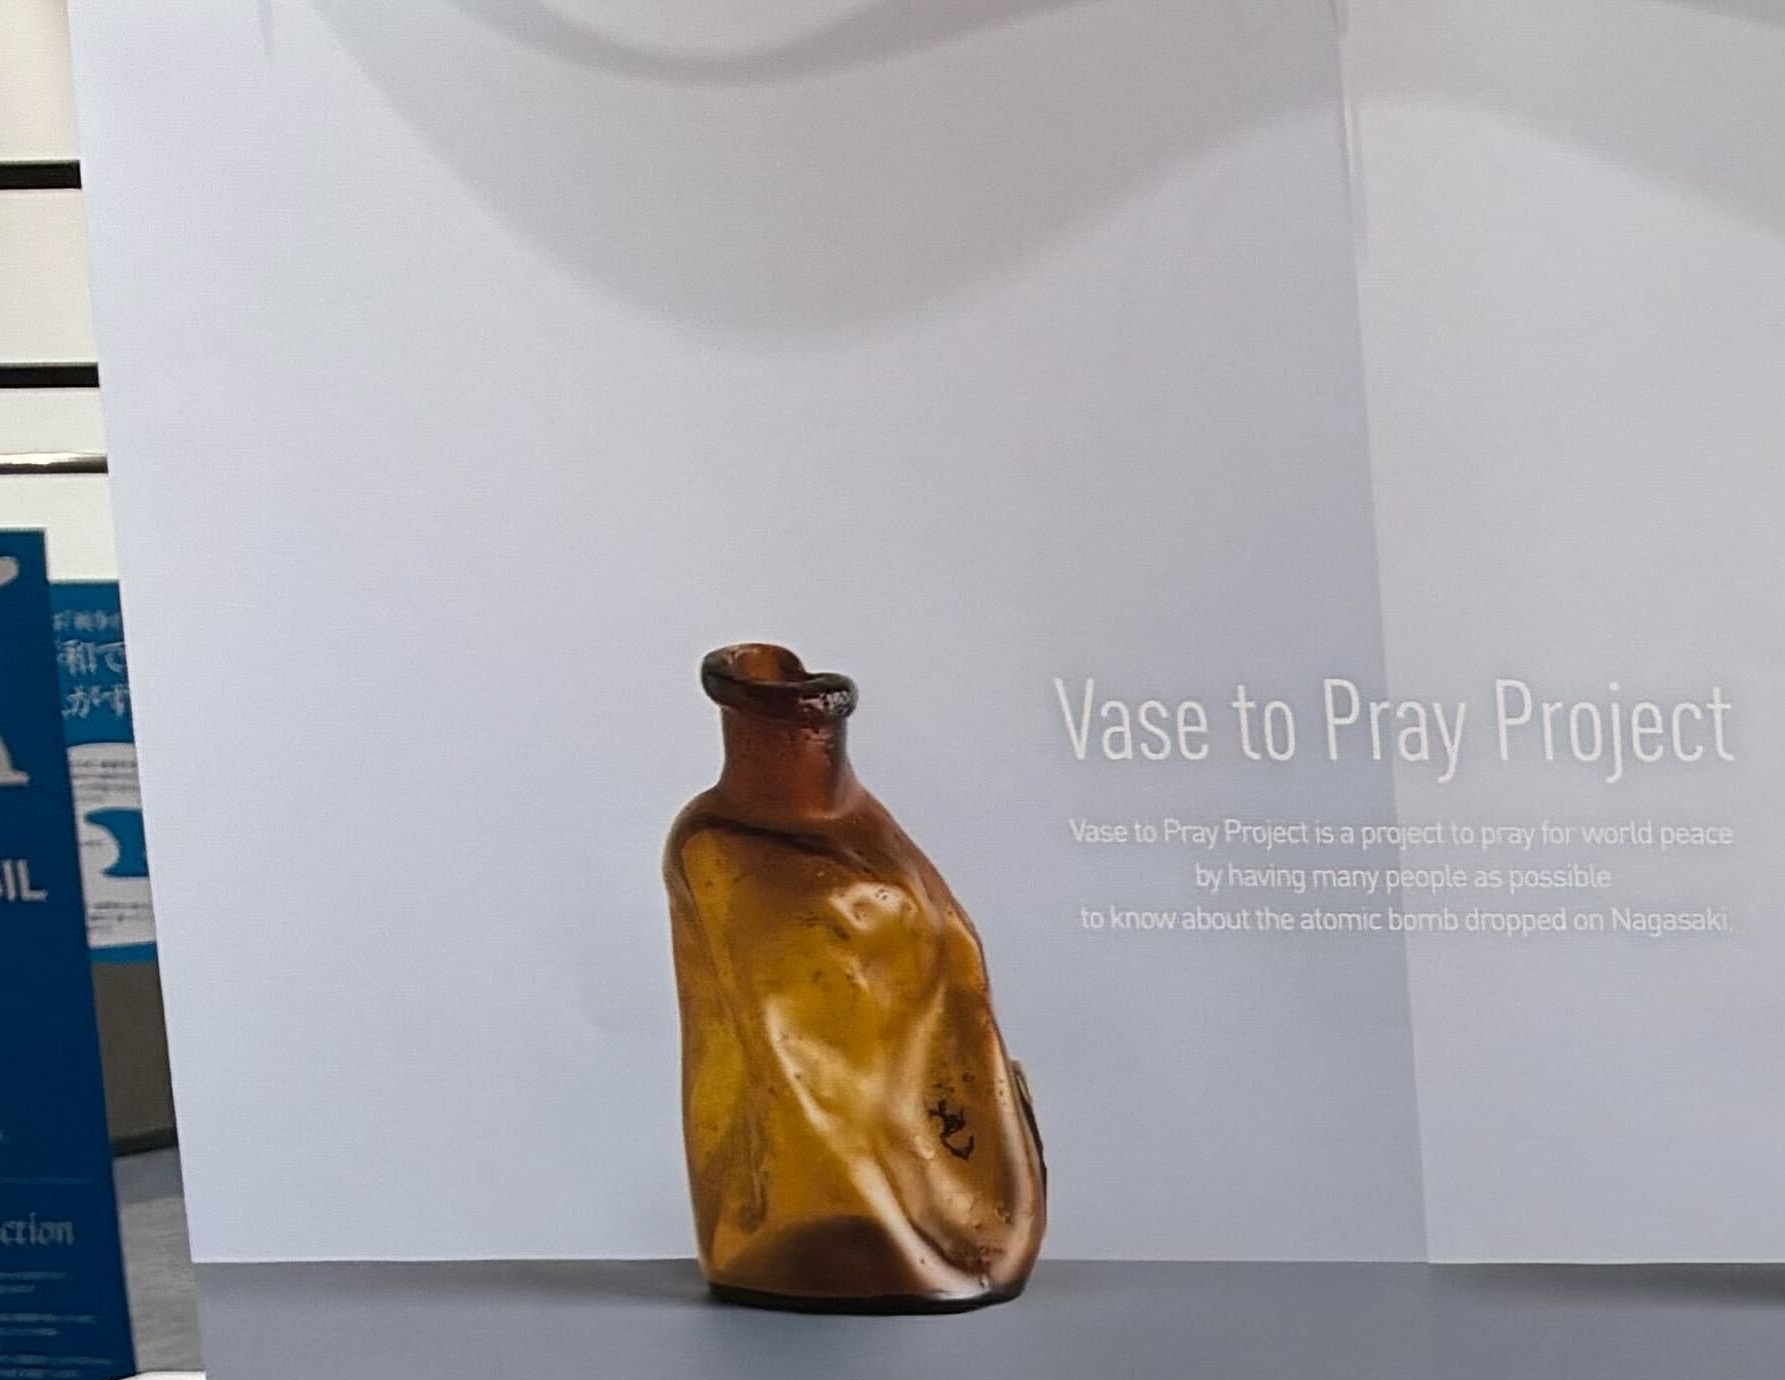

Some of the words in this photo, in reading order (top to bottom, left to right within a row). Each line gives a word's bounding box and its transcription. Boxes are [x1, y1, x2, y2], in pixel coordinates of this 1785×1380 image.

[1054, 677, 1209, 761] Vase
[1231, 684, 1296, 761] to
[1323, 678, 1466, 784] Pray
[1495, 679, 1735, 784] Project
[1070, 819, 1128, 843] Vase
[1134, 821, 1157, 843] to
[1164, 819, 1218, 849] Pray
[1224, 819, 1309, 850] Project
[1315, 819, 1334, 843] is
[1340, 825, 1354, 843] a
[1362, 820, 1444, 850] project
[1451, 822, 1475, 845] to
[1481, 827, 1536, 850] pray
[1541, 821, 1575, 845] for
[1581, 820, 1652, 845] world
[1660, 826, 1734, 849] peace
[1196, 863, 1223, 893] by
[1228, 863, 1305, 893] having
[1312, 869, 1379, 893] many
[1386, 864, 1467, 895] people
[1474, 870, 1502, 888] as
[1509, 863, 1613, 894] possible
[1081, 907, 1104, 929] to
[1110, 905, 1177, 929] know
[1181, 906, 1250, 930] about
[1256, 906, 1295, 930] the
[1300, 907, 1383, 931] atomic
[1389, 907, 1459, 932] bomb
[1465, 907, 1567, 937] dropped
[1573, 911, 1604, 932] on
[1610, 906, 1734, 937] Nagasaki.
